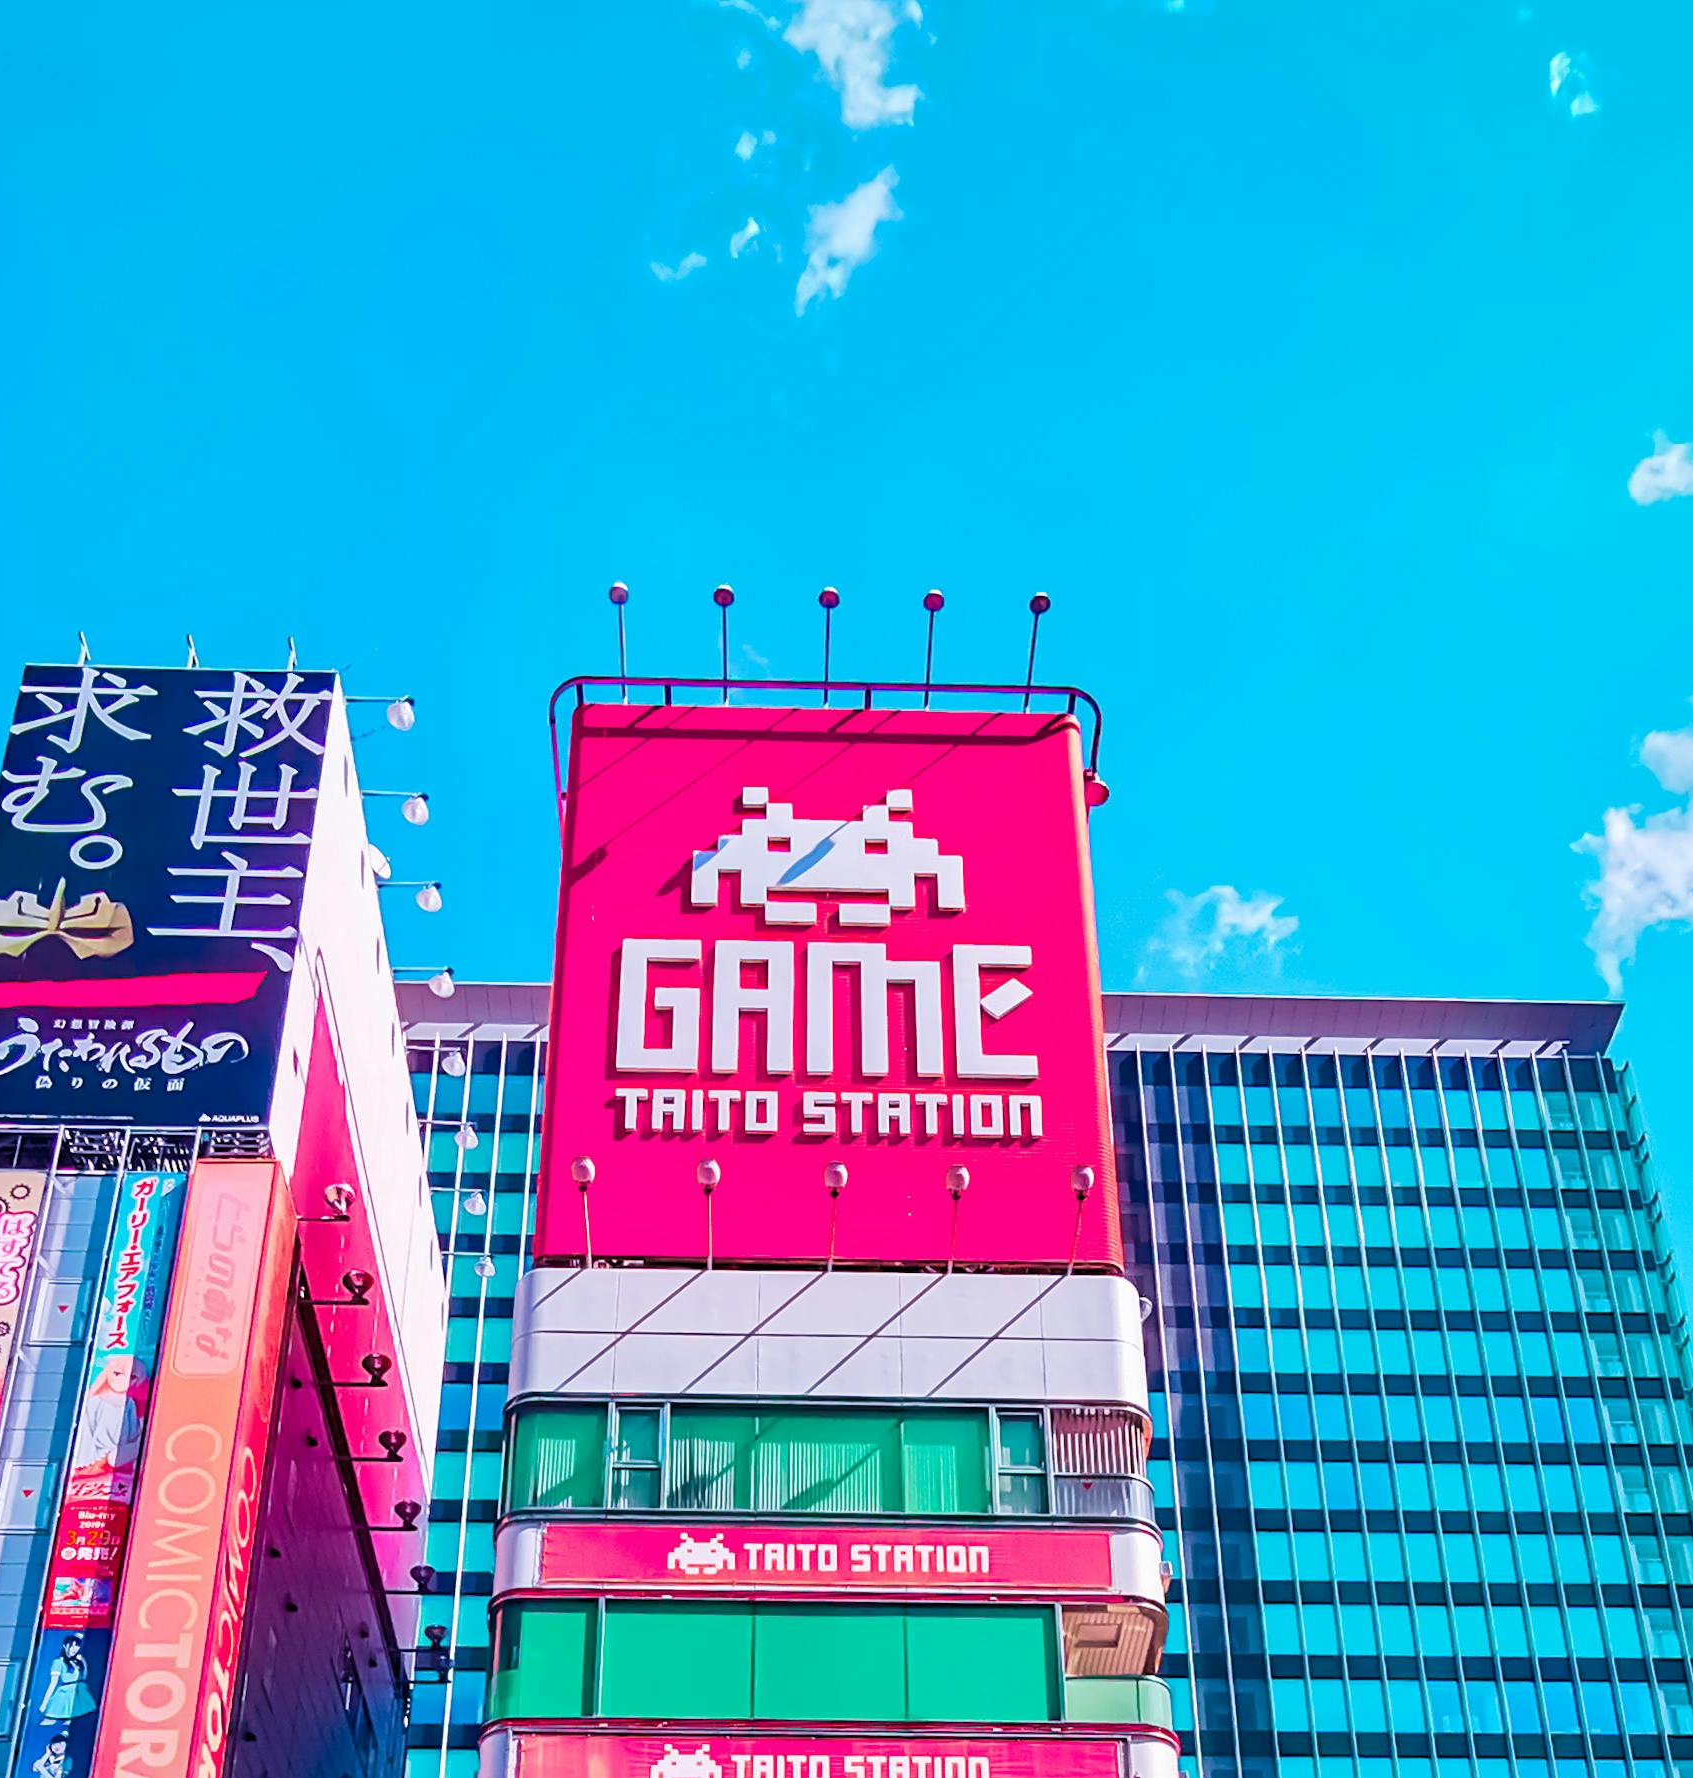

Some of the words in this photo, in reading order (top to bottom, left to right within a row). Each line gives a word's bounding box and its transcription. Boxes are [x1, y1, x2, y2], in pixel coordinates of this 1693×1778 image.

[0, 667, 158, 870] 求む。
[146, 672, 333, 973] 救世主、
[614, 937, 1039, 1080] GAME
[614, 1087, 780, 1135] TAITO
[802, 1091, 1043, 1139] STATION
[744, 1542, 838, 1572] TAITO
[851, 1543, 990, 1574] STATION
